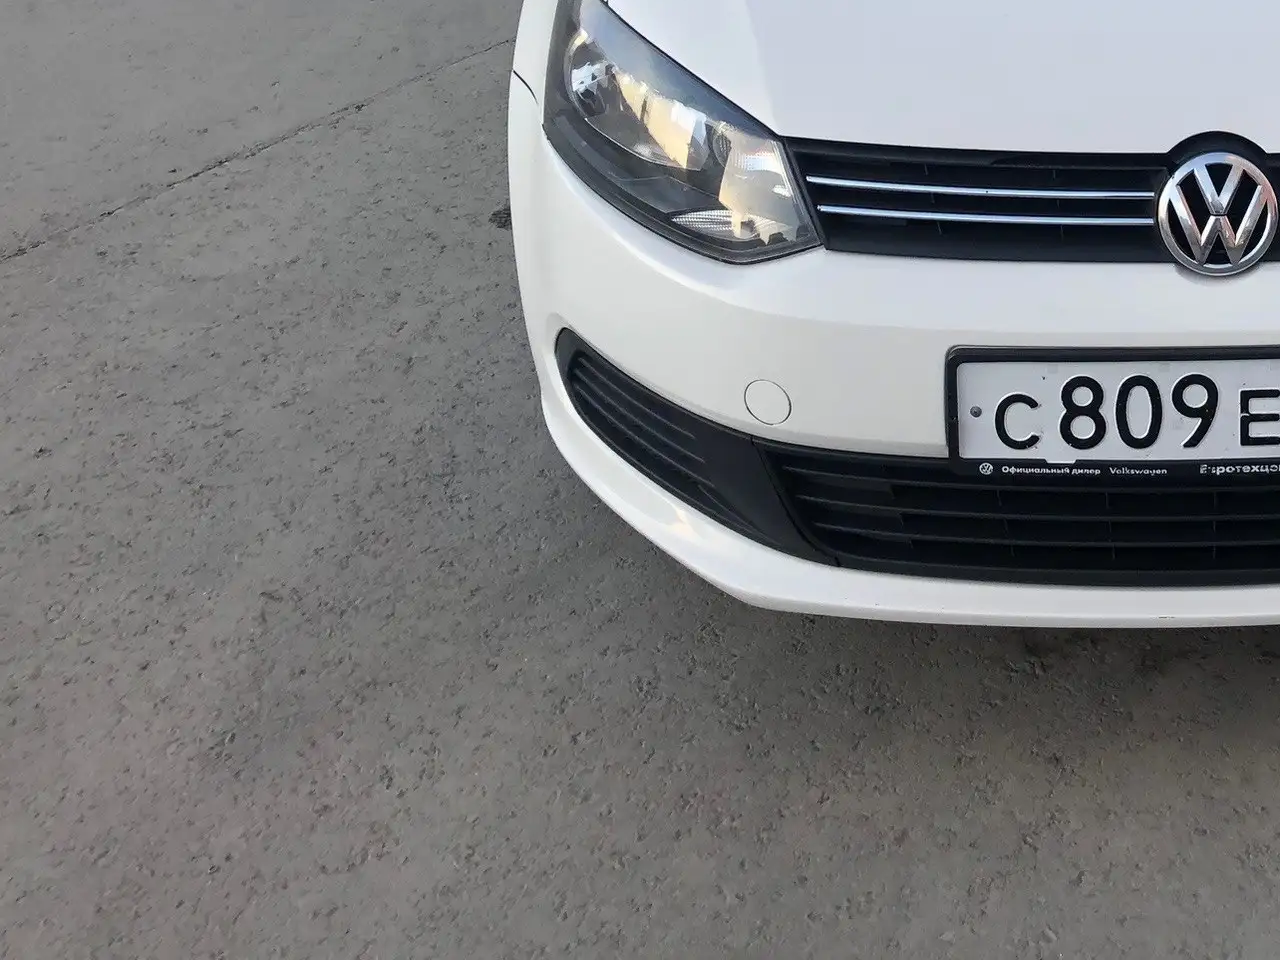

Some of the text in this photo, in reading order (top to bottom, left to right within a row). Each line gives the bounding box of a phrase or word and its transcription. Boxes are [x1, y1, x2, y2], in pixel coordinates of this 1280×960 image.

[1001, 464, 1101, 476] Официальный дилер
[1109, 466, 1168, 477] Volkswagen
